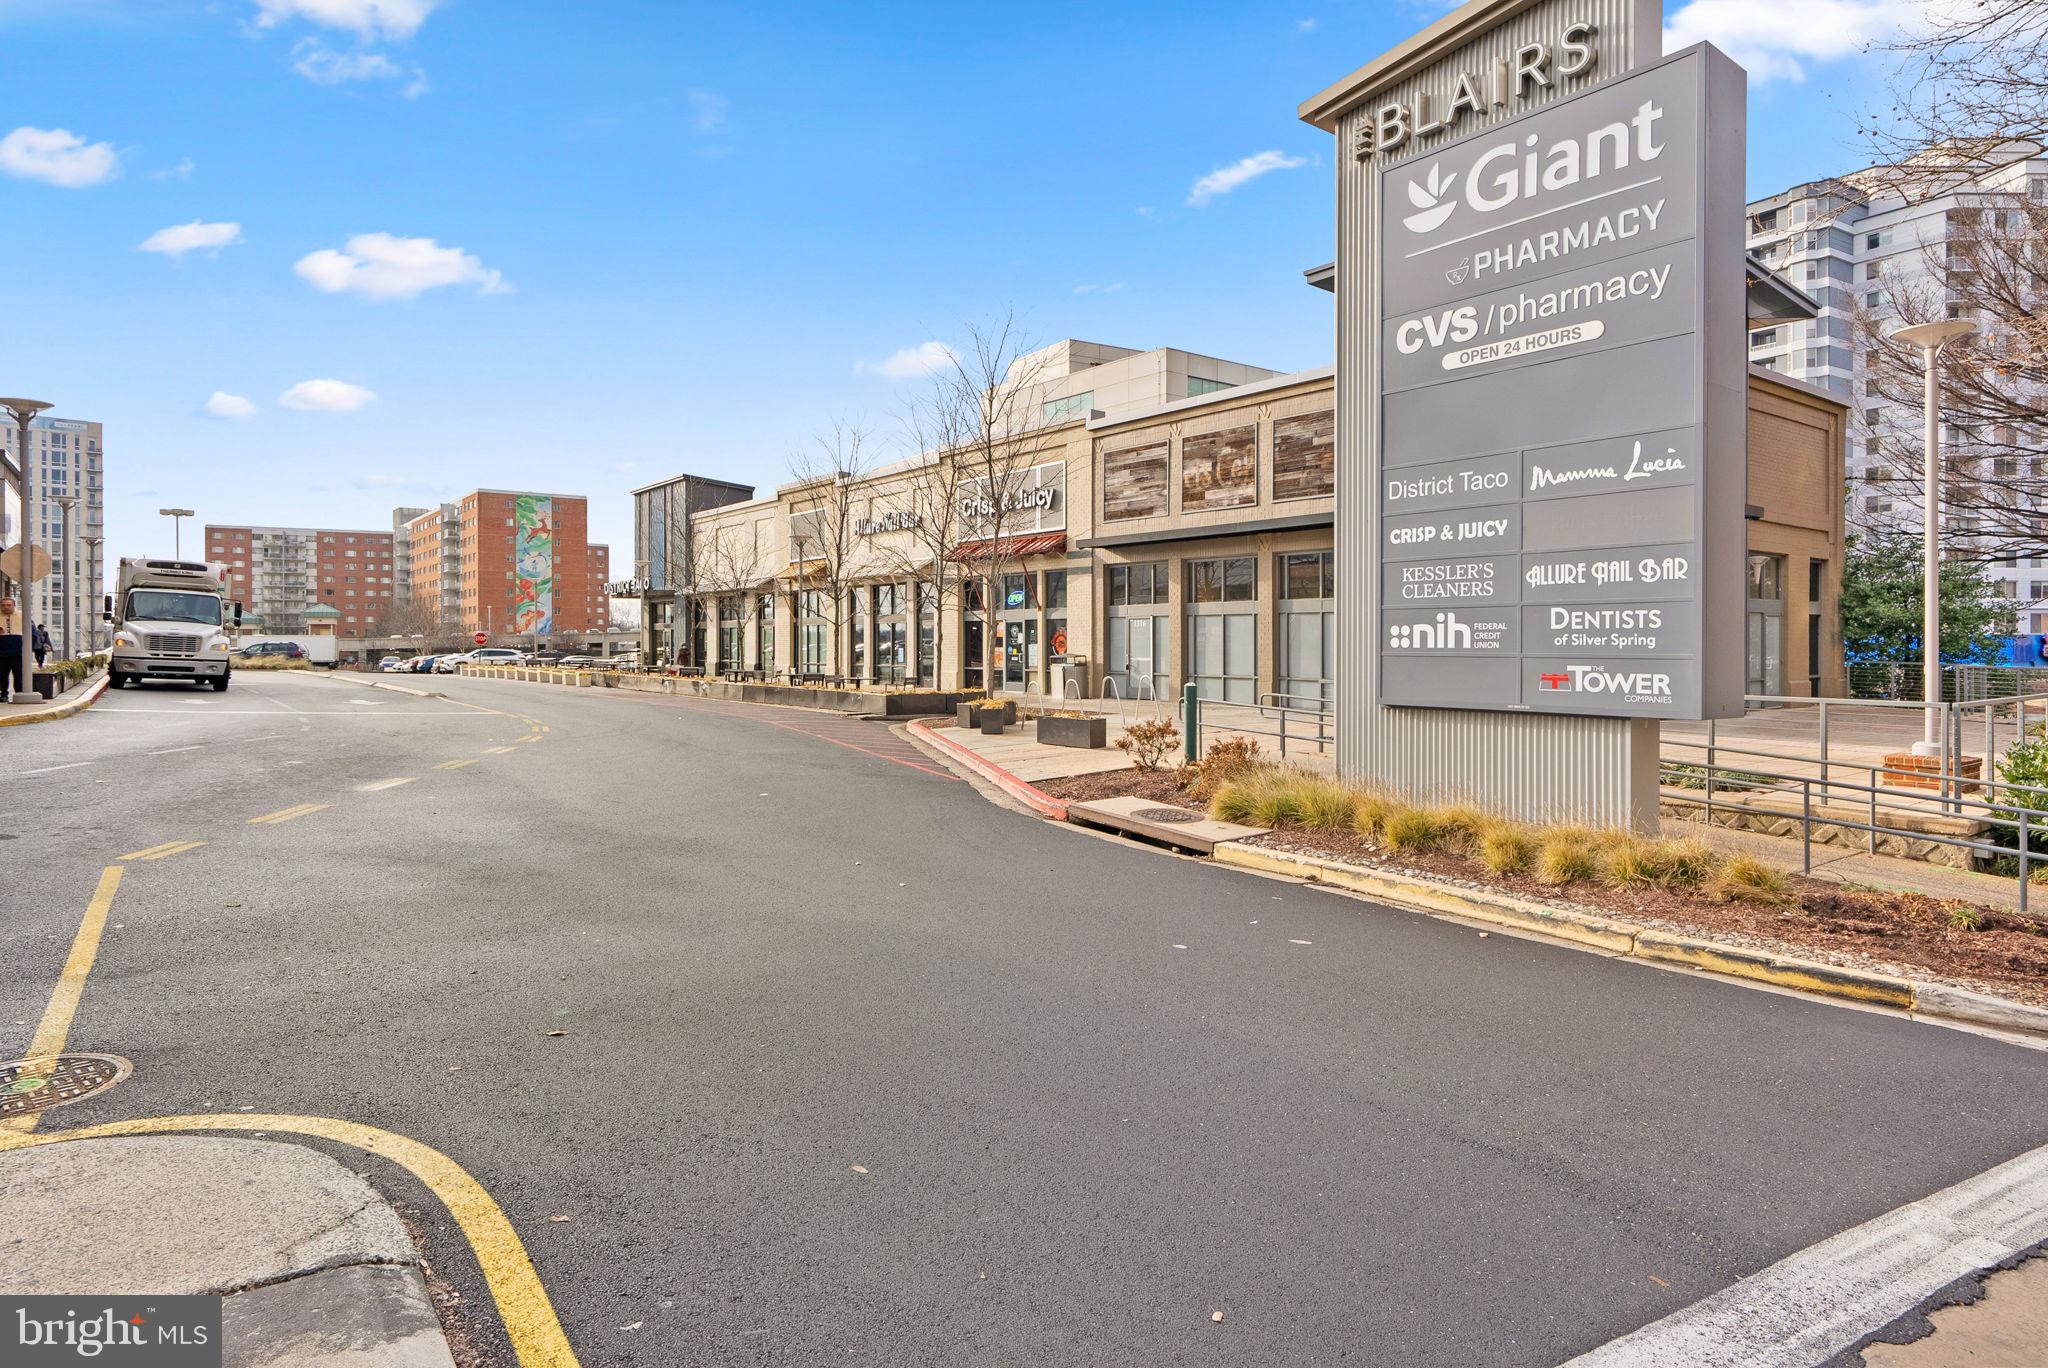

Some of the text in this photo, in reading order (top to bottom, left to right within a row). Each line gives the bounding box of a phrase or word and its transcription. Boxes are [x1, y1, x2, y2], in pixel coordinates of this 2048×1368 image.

[1377, 22, 1599, 151] BLAIRS
[1465, 99, 1667, 213] Giant
[1474, 198, 1666, 279] PHARMACY
[1459, 326, 1582, 364] OPEN 24 HOURS
[1529, 440, 1686, 491] Mamma Lucia
[1015, 487, 1055, 510] Juicy
[1388, 471, 1509, 500] District Taco
[1389, 519, 1508, 545] CRISP & JUICY
[1402, 562, 1494, 582] KESSLER'S
[1525, 557, 1688, 589] ALLURE NAIL BAR
[1402, 580, 1494, 599] CLEANERS
[1412, 612, 1471, 649] nih
[1473, 622, 1507, 630] FEDERAL
[1550, 607, 1662, 630] DENTISTS
[1473, 632, 1501, 640] CREDIT
[1473, 641, 1500, 649] UNION
[1554, 633, 1656, 649] of Silver Spring
[1566, 665, 1672, 695] TOWER
[1624, 694, 1673, 704] COMPANIES
